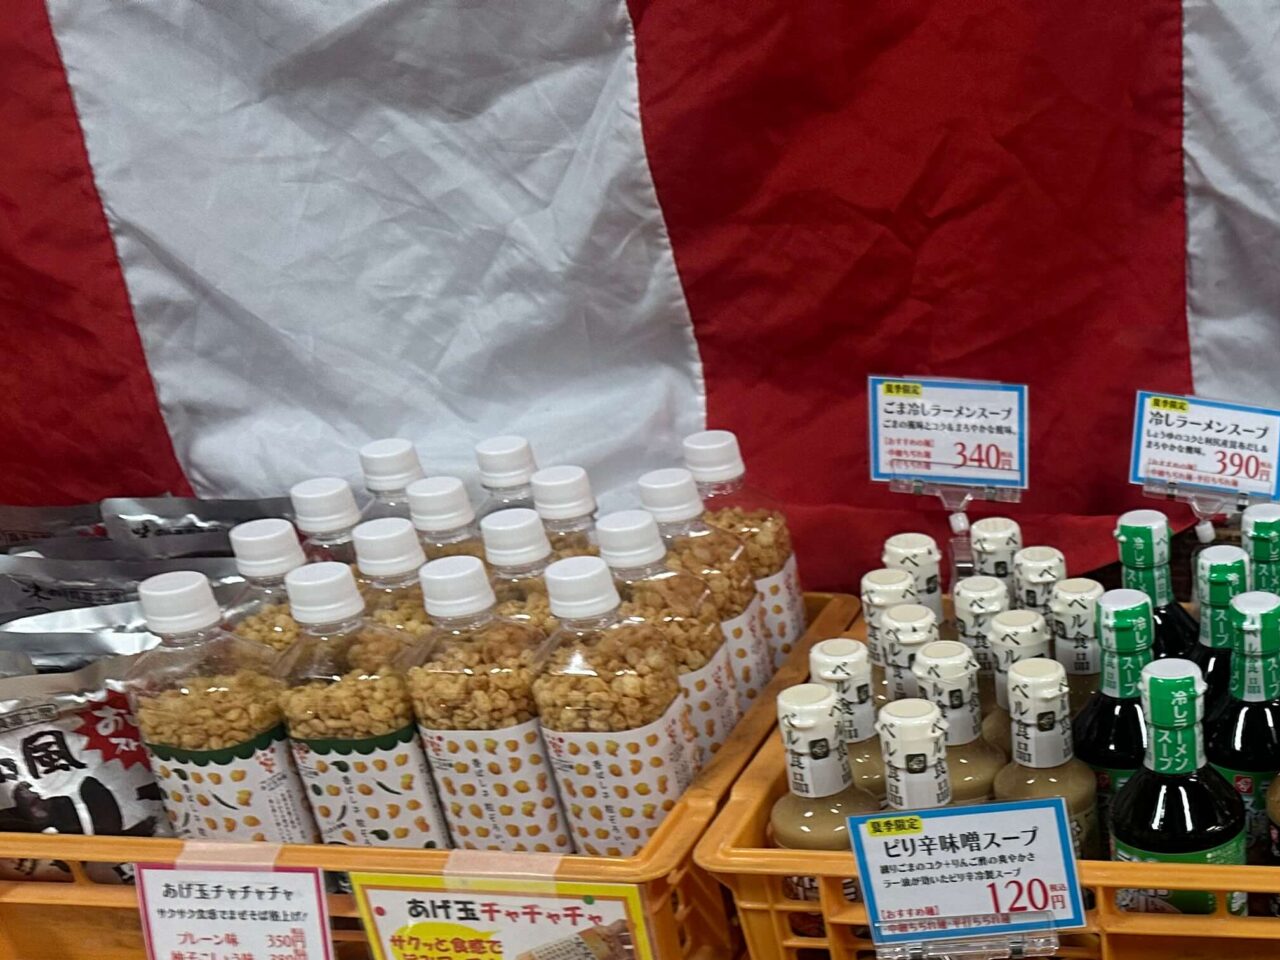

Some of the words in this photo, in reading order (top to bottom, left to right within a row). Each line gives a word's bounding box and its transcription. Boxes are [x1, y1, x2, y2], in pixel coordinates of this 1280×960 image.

[883, 402, 1013, 420] ごま冷しラーメンスープ
[1149, 411, 1269, 439] 冷しラーメンスープ
[1158, 730, 1173, 770] スープ
[870, 818, 920, 833] 夏季限定
[884, 826, 1039, 858] ピリ辛味噌スープ
[162, 883, 294, 900] あげ玉チャチャチャ
[407, 898, 603, 925] あげ玉チャチャチャ
[177, 932, 239, 946] プレーン味
[390, 935, 503, 955] サクッと食感で
